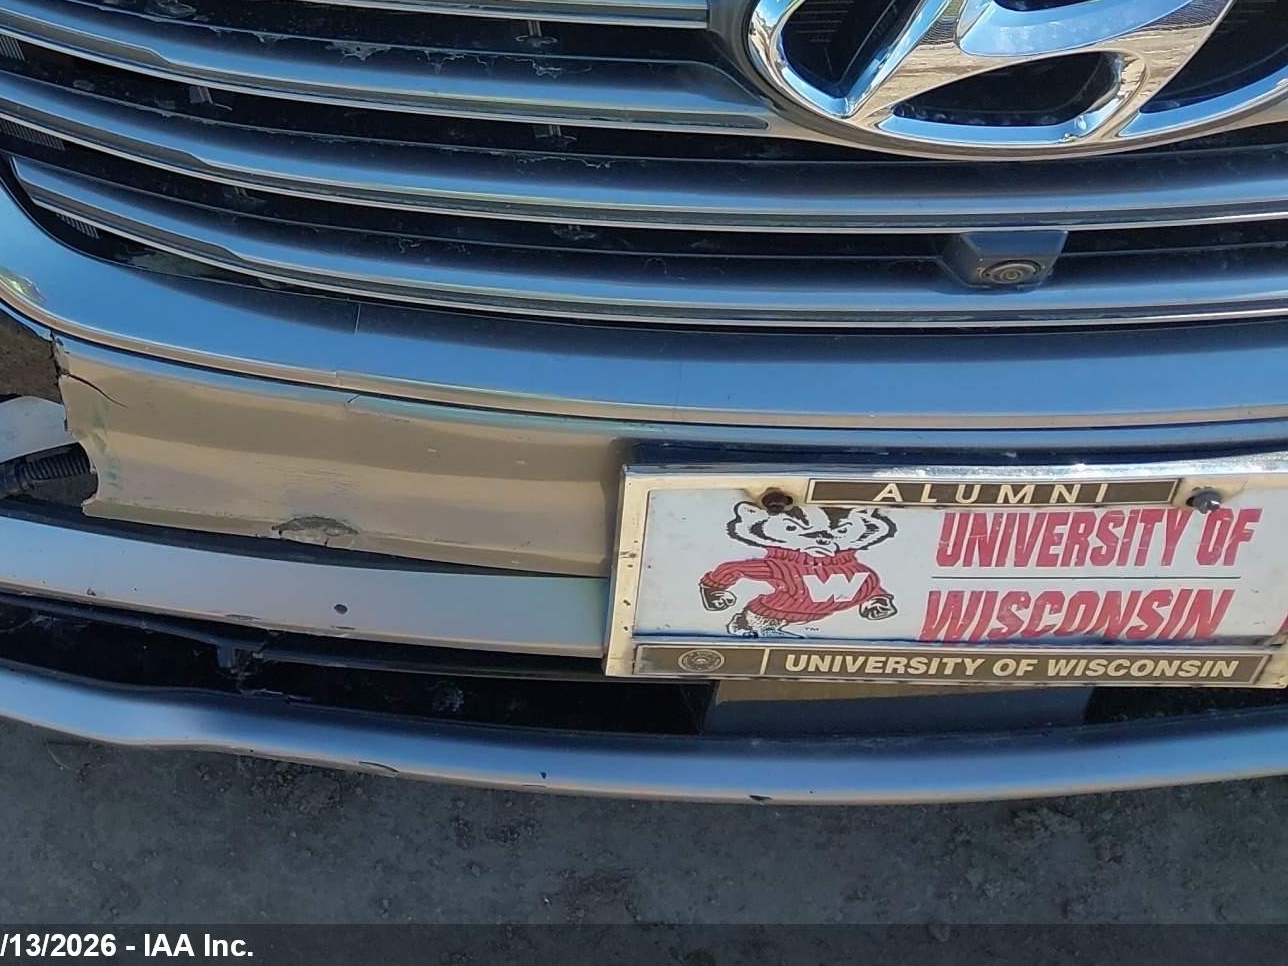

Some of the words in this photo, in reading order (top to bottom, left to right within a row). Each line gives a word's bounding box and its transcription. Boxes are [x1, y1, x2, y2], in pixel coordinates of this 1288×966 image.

[872, 482, 1109, 504] ALUMNI
[936, 508, 1194, 567] UNIVERSITY
[1196, 507, 1263, 567] OF
[802, 571, 870, 603] W
[918, 587, 1236, 644] WISCONSIN
[785, 654, 985, 677] UNIVERSITY
[992, 658, 1038, 677] OF
[1047, 658, 1240, 678] WISCONSIN
